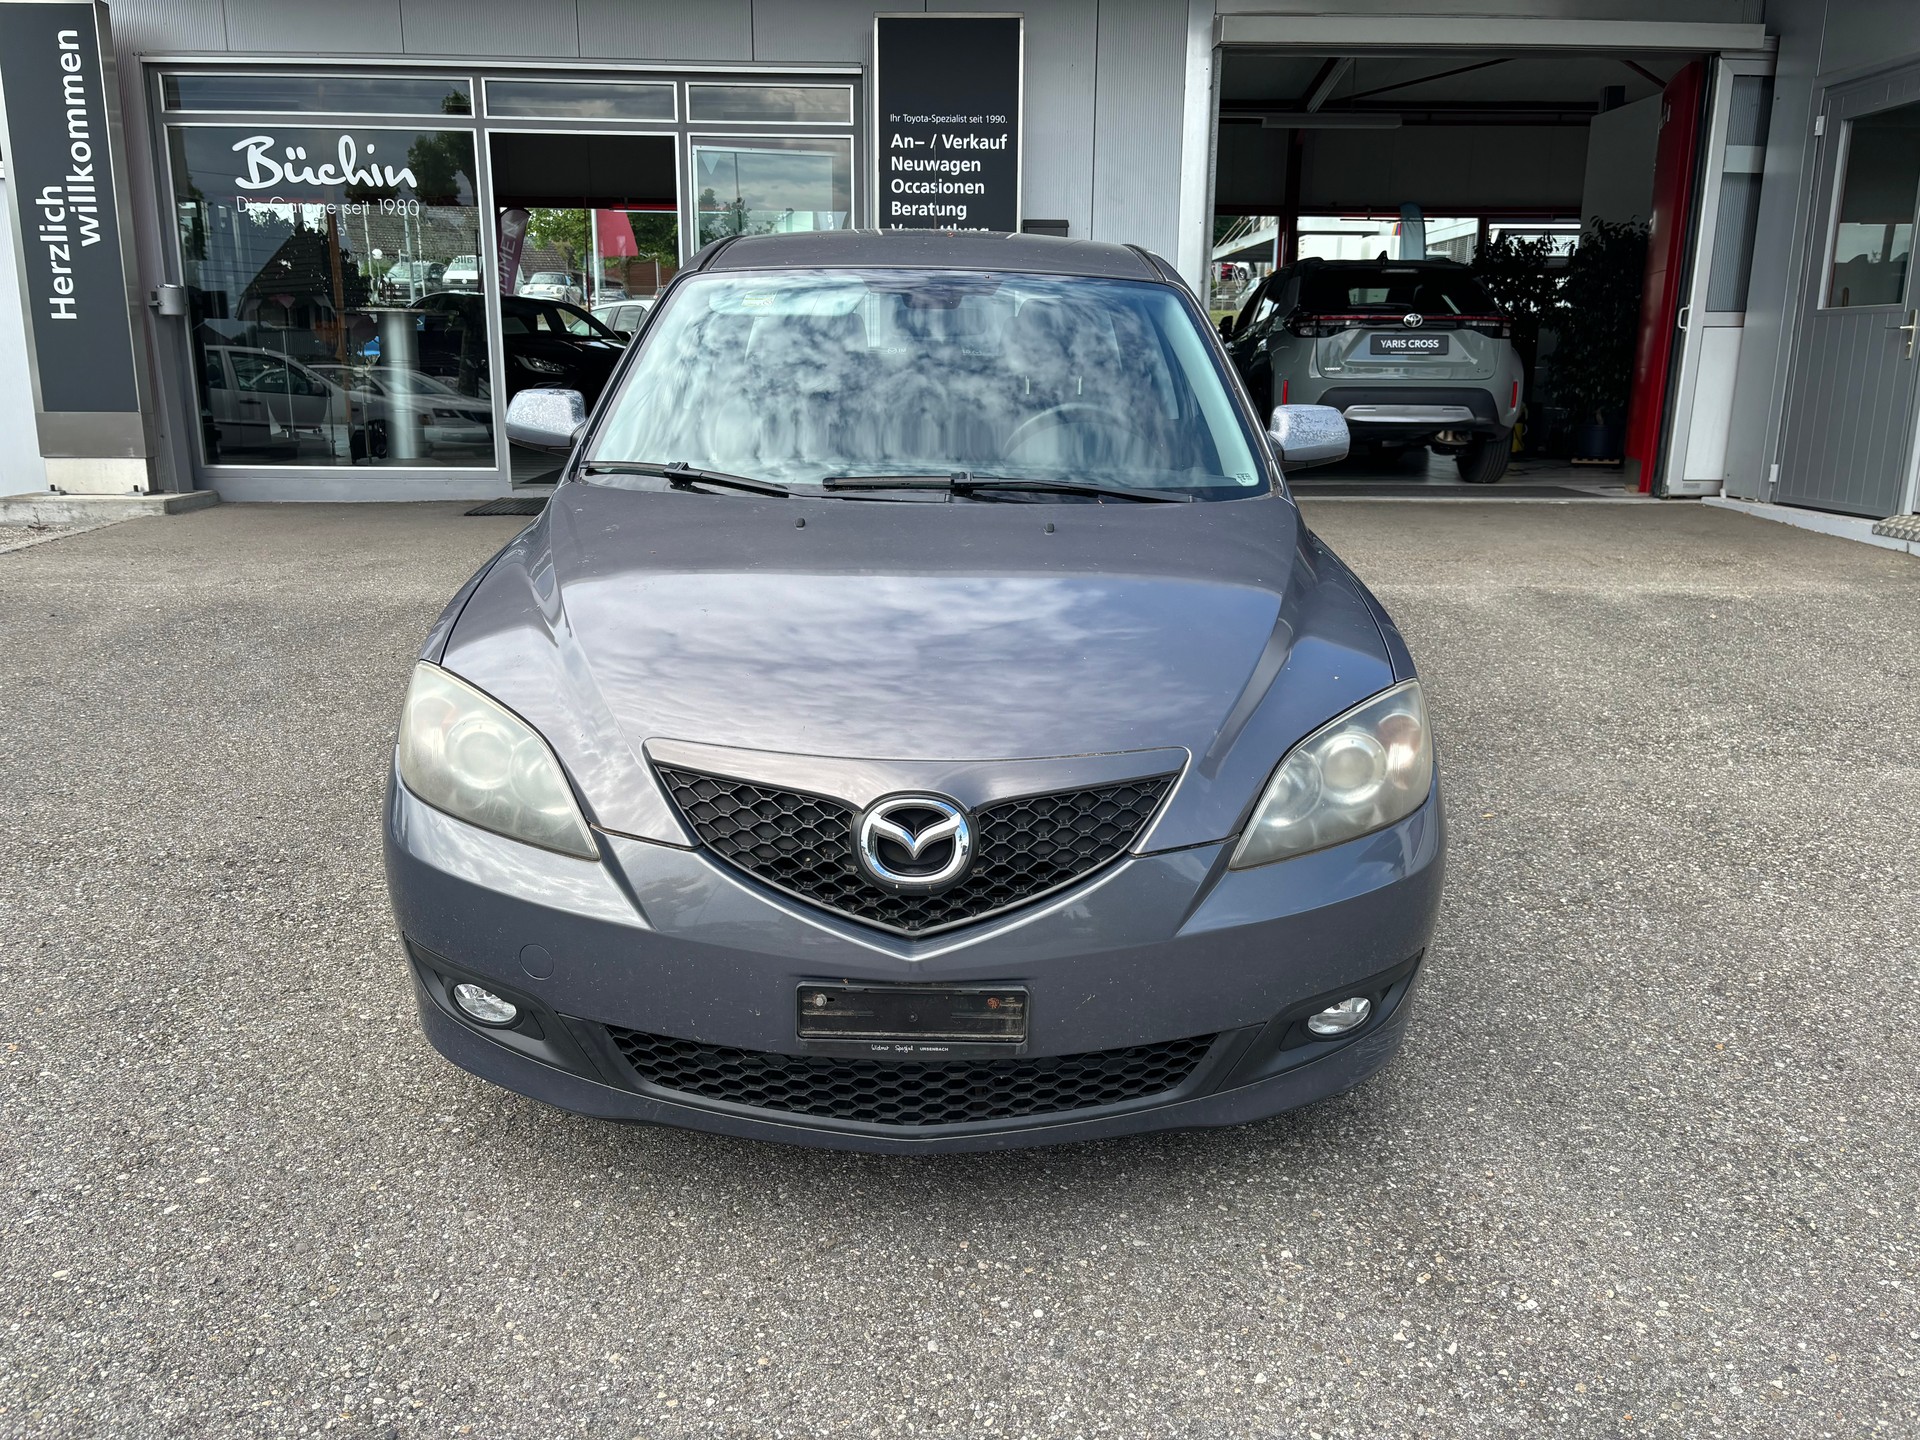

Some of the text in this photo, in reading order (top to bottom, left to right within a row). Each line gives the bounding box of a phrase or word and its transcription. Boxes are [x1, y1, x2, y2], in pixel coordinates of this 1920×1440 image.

[890, 113, 1008, 124] Ihr Toyota-Spezialist seit 1990.
[57, 29, 101, 247] willkommen
[941, 133, 1008, 150] Verkauf
[232, 134, 418, 190] Büchin
[891, 156, 981, 175] Neuwagen
[890, 178, 985, 194] Occasionen
[236, 196, 420, 219] Die Garage seit 1980
[891, 201, 967, 220] Beratung
[35, 186, 78, 320] Herzlich
[1380, 339, 1439, 349] YARIS CROSS
